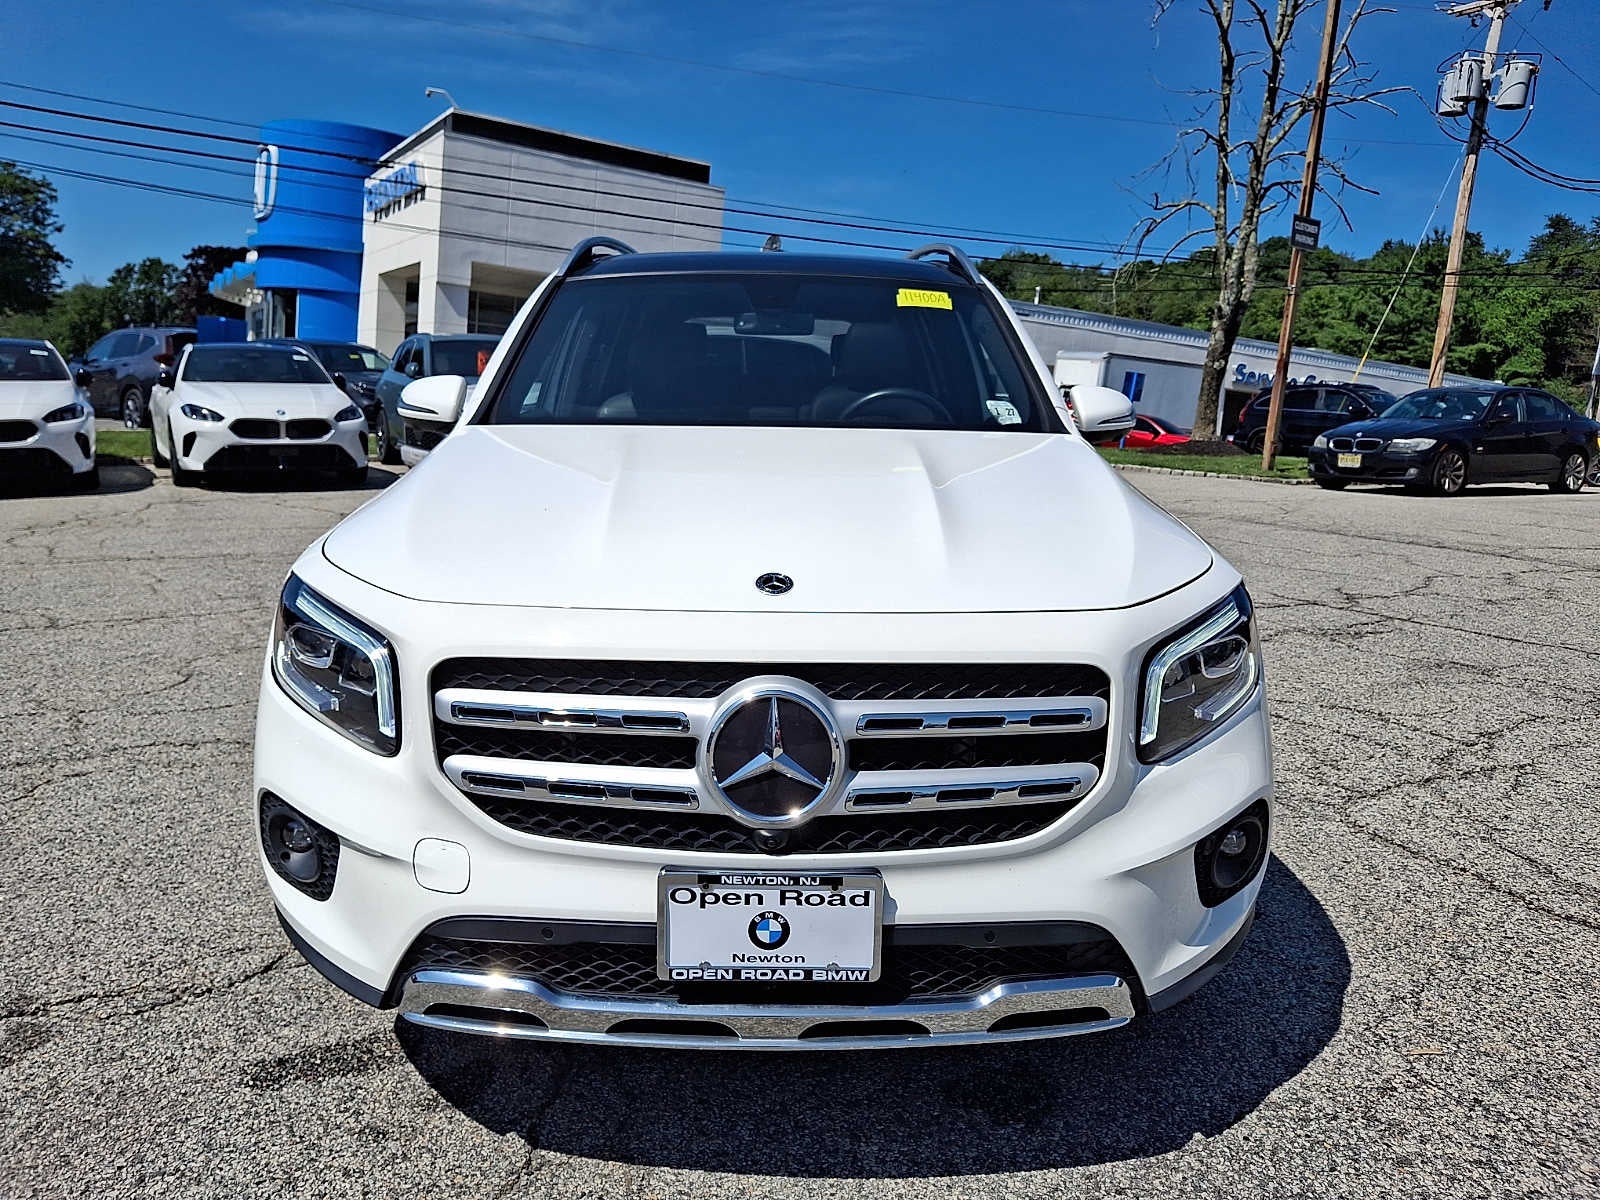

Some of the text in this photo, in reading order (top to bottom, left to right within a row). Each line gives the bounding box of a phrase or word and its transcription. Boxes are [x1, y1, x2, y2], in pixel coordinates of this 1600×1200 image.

[721, 875, 820, 886] NEWTON, NJ
[669, 887, 870, 910] Open Road
[754, 912, 787, 924] BMW
[732, 953, 806, 964] Newton
[671, 969, 867, 981] OPEN ROAD BMW
